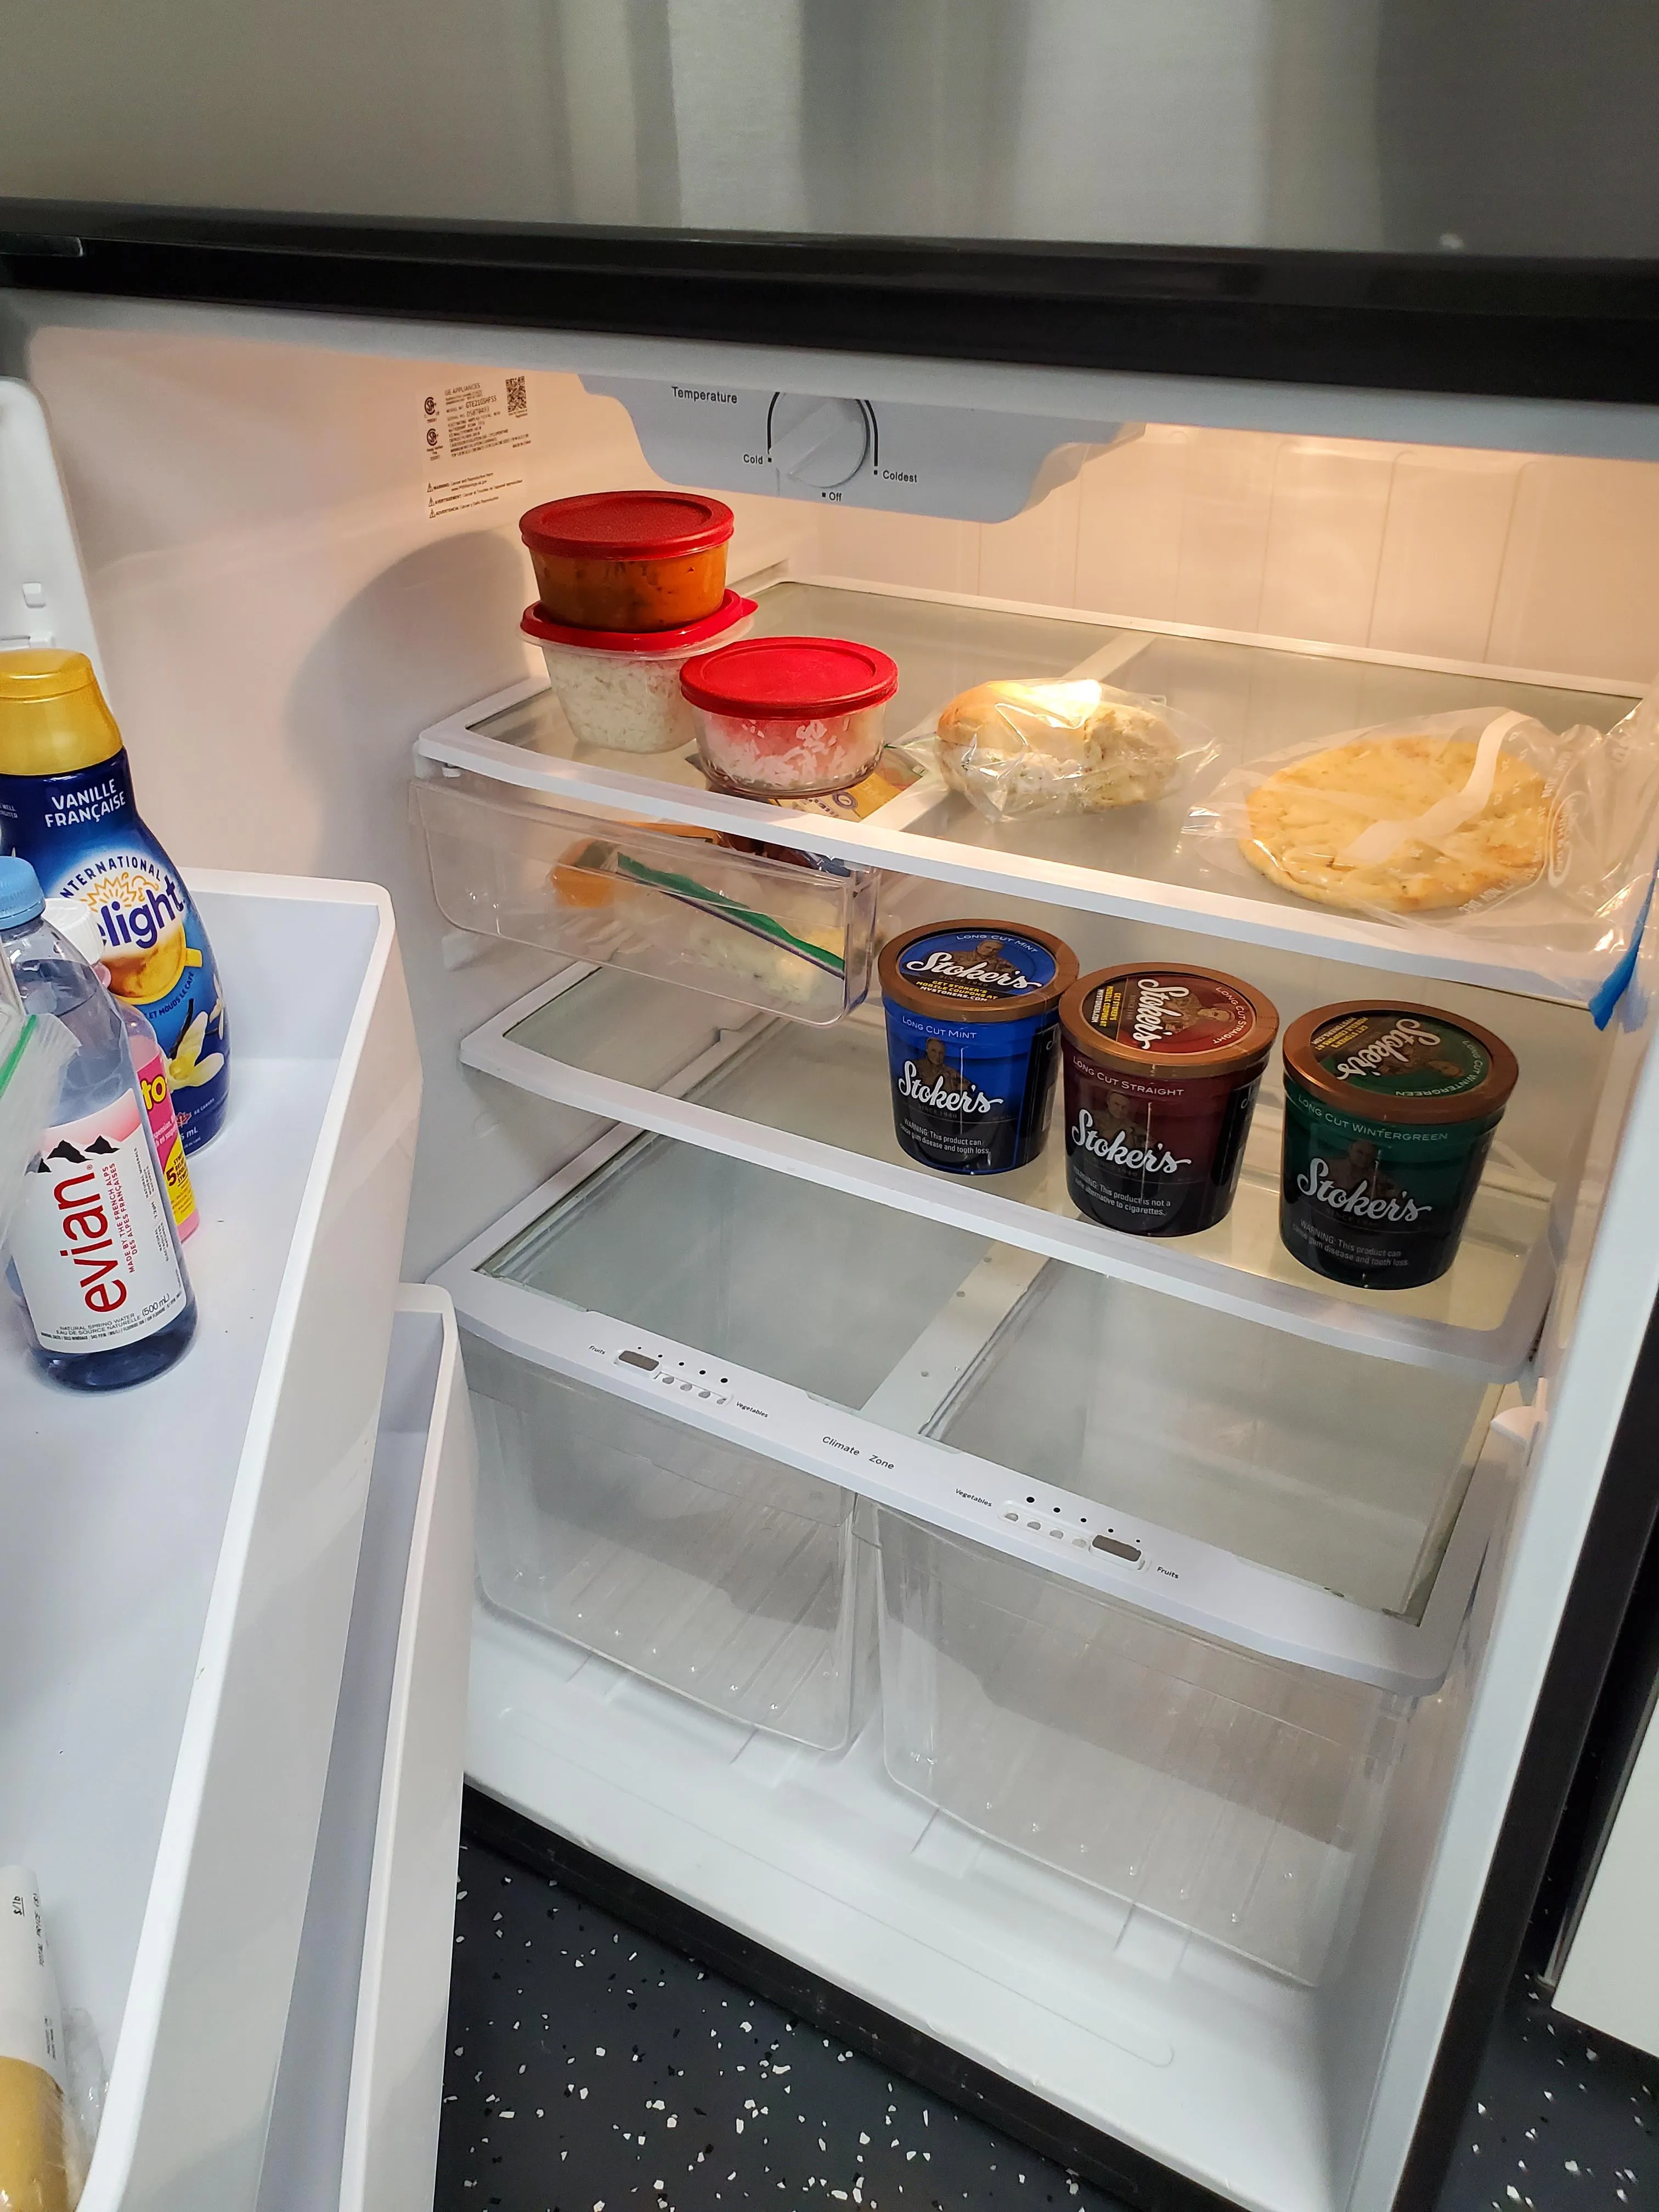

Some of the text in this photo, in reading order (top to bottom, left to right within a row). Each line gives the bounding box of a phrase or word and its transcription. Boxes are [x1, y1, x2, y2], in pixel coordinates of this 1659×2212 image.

[453, 383, 481, 393] APPLIANCES
[671, 386, 738, 405] Temperature
[743, 454, 764, 465] Cold
[882, 470, 918, 483] Coldest
[828, 492, 843, 503] Off
[52, 778, 117, 810] VANILLE
[44, 791, 126, 827] FRANÇAISE
[59, 855, 161, 899] NTERNATIONAL
[97, 875, 184, 949] light
[1458, 900, 1483, 915] DEC
[1014, 940, 1039, 953] MINT
[906, 952, 1043, 989] Stoker's
[916, 981, 948, 991] MOBILE
[949, 987, 986, 998] COUPONS
[949, 983, 988, 994] STOKER'S
[902, 1015, 978, 1039] LONG CUT MINT
[1132, 978, 1190, 1050] Stoker's
[1211, 987, 1248, 1045] LONG CUT STRAIGHT
[1335, 1018, 1441, 1081] Stoker's
[1073, 1056, 1184, 1096] LONG CUT STRAIGHT
[1395, 1040, 1484, 1097] LONG CUT WINTERGREEN
[898, 1060, 1004, 1113] Stoker's
[1299, 1094, 1448, 1141] LONG CUT WINTERGREEN
[187, 1126, 198, 1138] mL
[905, 1118, 929, 1137] WARNING:
[929, 1130, 943, 1141] This
[943, 1136, 968, 1146] product
[911, 1132, 922, 1142] gum
[922, 1137, 943, 1149] disease
[944, 1143, 956, 1152] and
[1071, 1109, 1192, 1173] Stoker's
[109, 1163, 127, 1212] FRANÇAISES
[166, 1166, 177, 1186] 5
[1074, 1166, 1098, 1188] WARNING:
[1099, 1183, 1113, 1196] This
[1114, 1191, 1141, 1204] product
[1143, 1197, 1149, 1205] is
[1151, 1199, 1165, 1207] not
[1297, 1157, 1432, 1223] Stoker's
[1085, 1185, 1115, 1206] alternative
[1116, 1200, 1124, 1209] to
[1124, 1204, 1166, 1216] cigarettes.
[102, 1166, 136, 1273] MADE BY THE FRENCH ALPS
[122, 1214, 133, 1238] ALPES
[53, 1171, 128, 1313] evian
[1300, 1218, 1335, 1244] WARNING:
[1338, 1239, 1355, 1251] This
[1356, 1246, 1386, 1257] product
[1308, 1236, 1323, 1249] gum
[1324, 1244, 1354, 1261] disease
[1356, 1255, 1370, 1265] and
[142, 1302, 159, 1317] (500
[159, 1293, 170, 1307] mL)
[78, 1327, 106, 1335] SOURCE
[107, 1315, 141, 1333] NATURELLE
[88, 1321, 112, 1329] SPRING
[114, 1313, 135, 1323] WATER
[589, 1345, 606, 1355] Fruits
[736, 1401, 769, 1418] Vegetables
[822, 1436, 895, 1470] Climate Zone
[955, 1488, 992, 1508] Vegetables
[1156, 1566, 1180, 1579] Fruits
